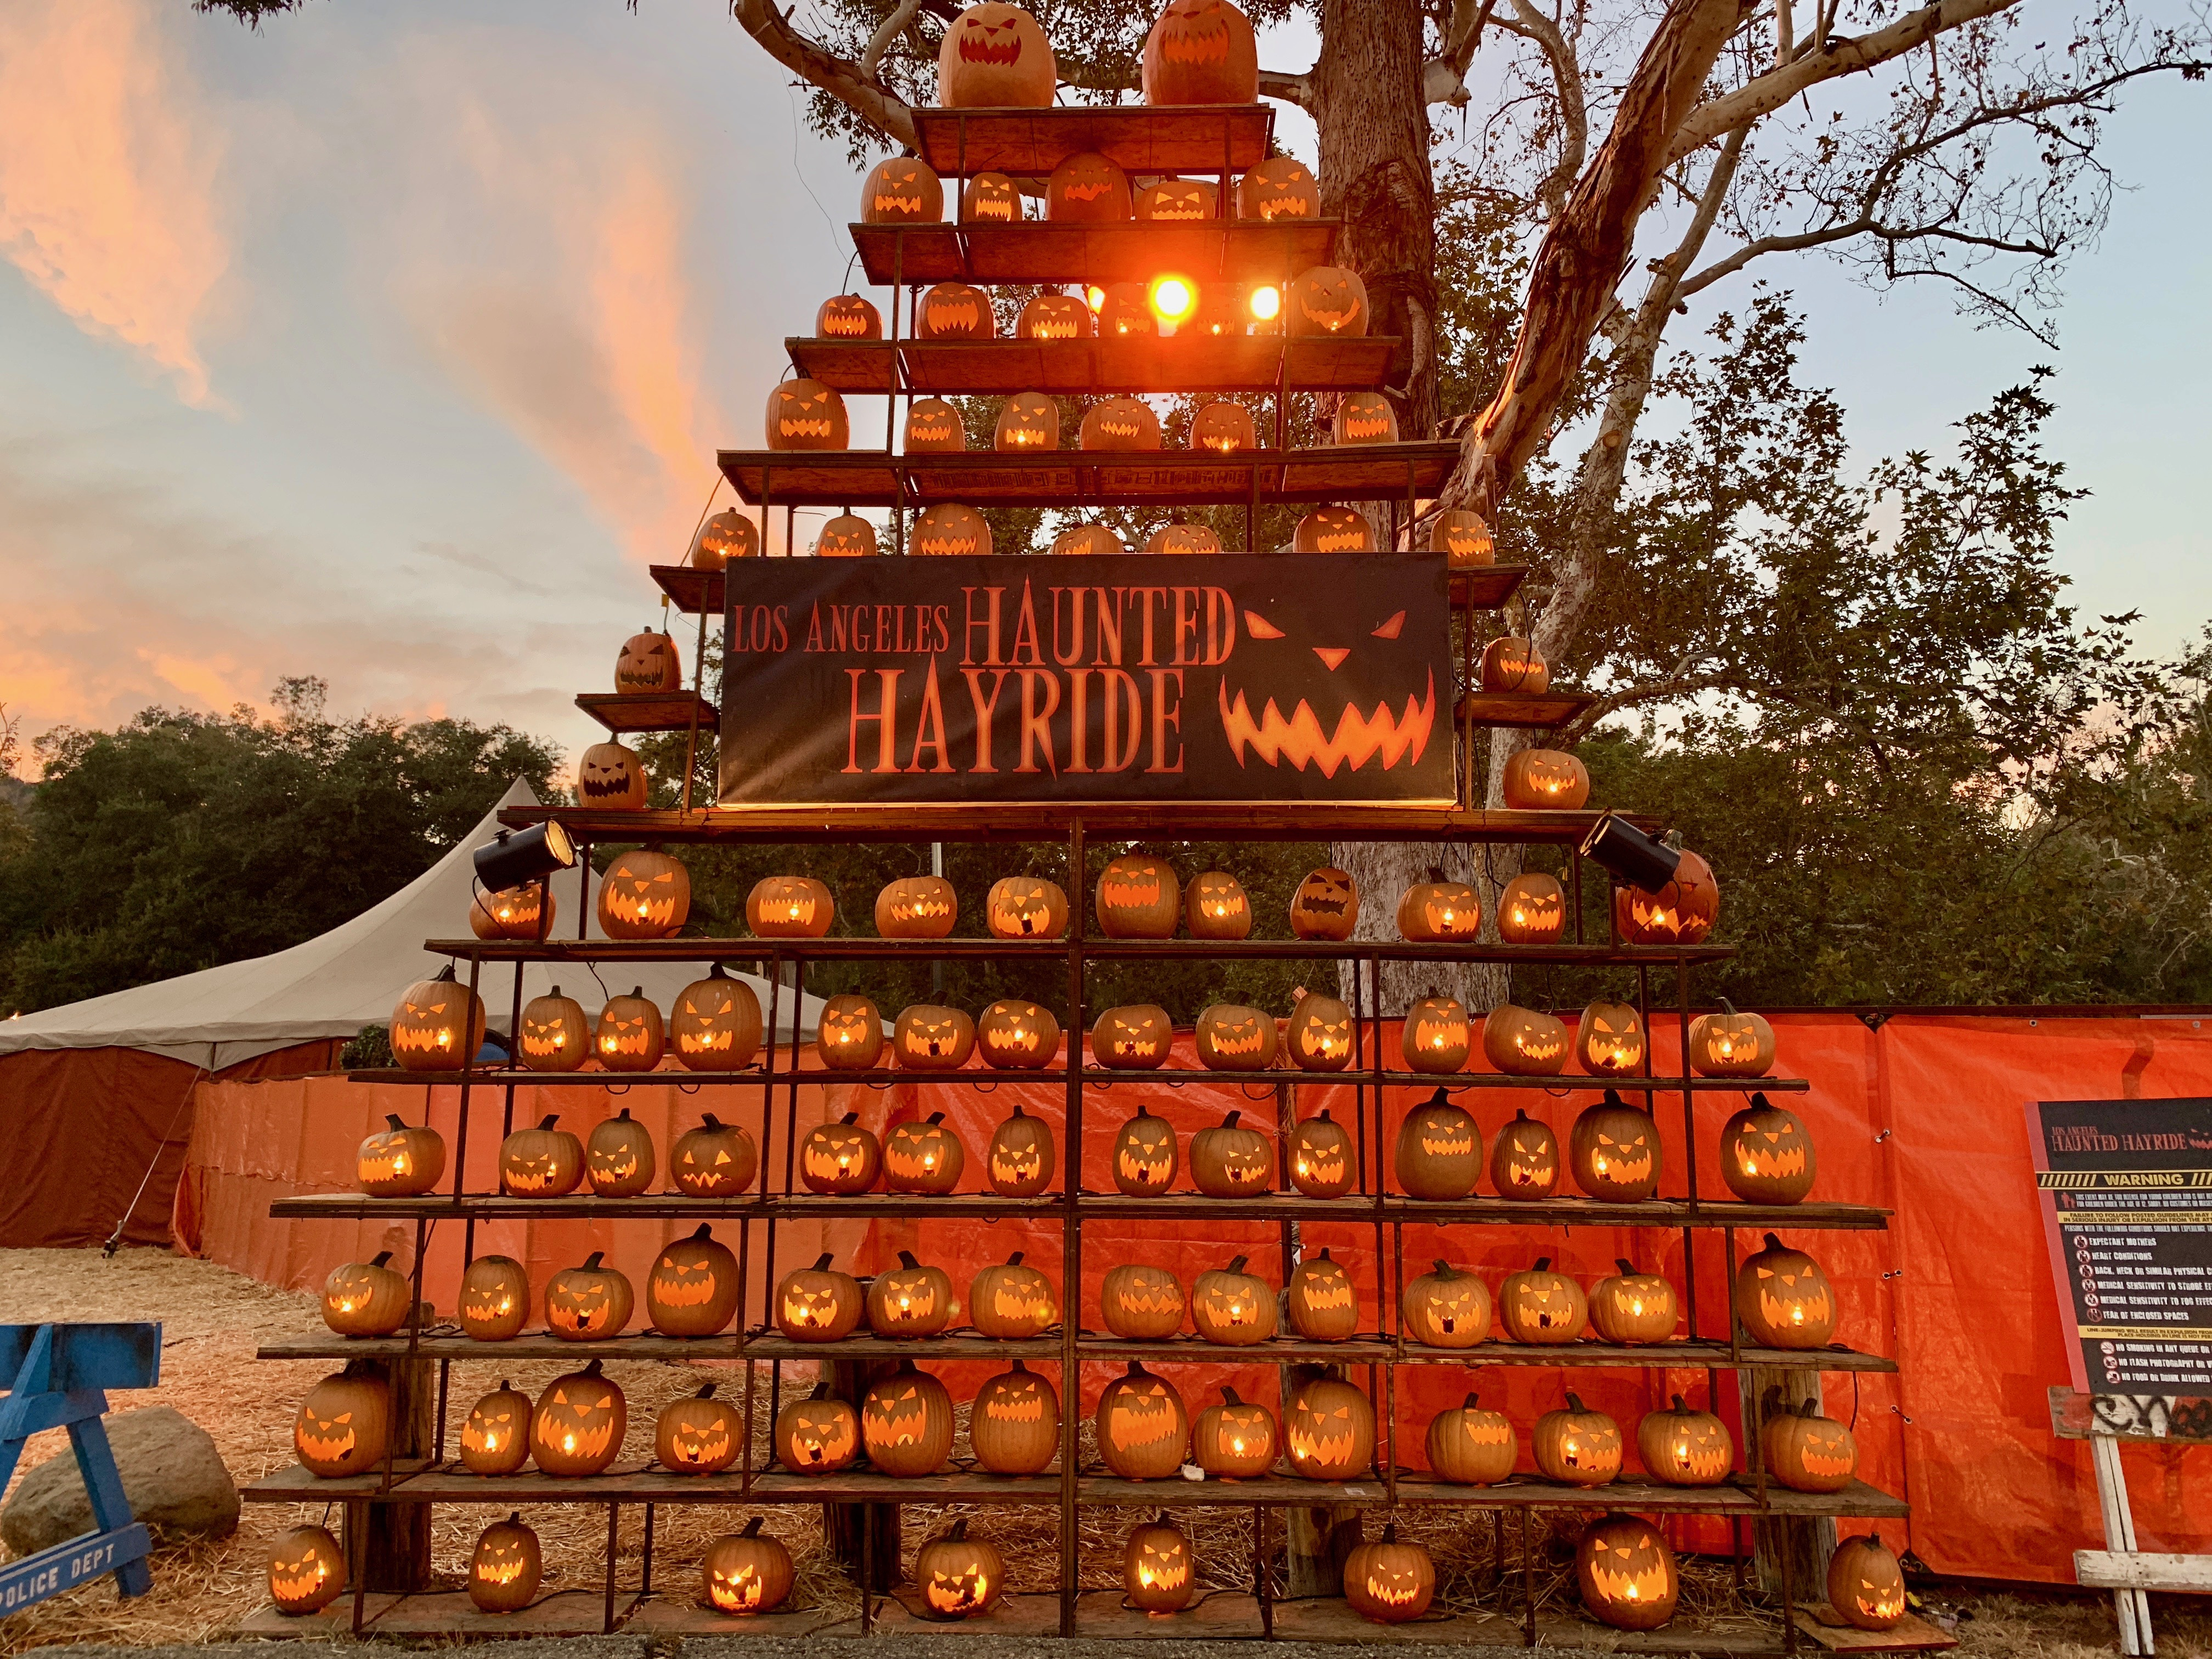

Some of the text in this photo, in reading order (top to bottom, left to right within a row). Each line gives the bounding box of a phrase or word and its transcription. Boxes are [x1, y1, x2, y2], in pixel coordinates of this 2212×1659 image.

[732, 573, 1235, 667] LOS ANGELES HAUNTED
[840, 651, 1183, 780] HAYRIDE
[2051, 1126, 2098, 1136] LOS ANGELES
[2051, 1133, 2188, 1151] HAUNTED HAYRIDE
[2103, 1173, 2184, 1186] WARNING
[2089, 1238, 2157, 1246] EXPECTANT MOTHERS
[2091, 1252, 2153, 1261] HEART CONDITIONS
[2116, 1267, 2134, 1275] NECK
[2135, 1267, 2145, 1276] OR
[2145, 1267, 2172, 1276] SIMILAR
[2173, 1267, 2205, 1276] PHYSICAL
[2097, 1281, 2124, 1290] MEDICAL
[2126, 1282, 2165, 1290] SENSITIVITY
[2167, 1282, 2176, 1290] TO
[2177, 1282, 2203, 1290] STROBE
[2100, 1296, 2128, 1305] MEDICAL
[2129, 1296, 2168, 1305] SENSITIVITY
[2169, 1297, 2179, 1305] TO
[2180, 1297, 2194, 1306] FOG
[2102, 1311, 2190, 1321] FEAR OF ENCLOSED SPACES
[2115, 1344, 2210, 1354] NO SMOKING IN ANY QUEUE OR
[2118, 1358, 2128, 1366] NO
[2129, 1358, 2149, 1367] FLASH
[2149, 1359, 2194, 1368] PHOTOGRAPHY
[2196, 1360, 2205, 1368] OR
[2121, 1373, 2210, 1383] NO FOOD OR DRINK ALLOWED
[71, 1544, 114, 1579] DEPT
